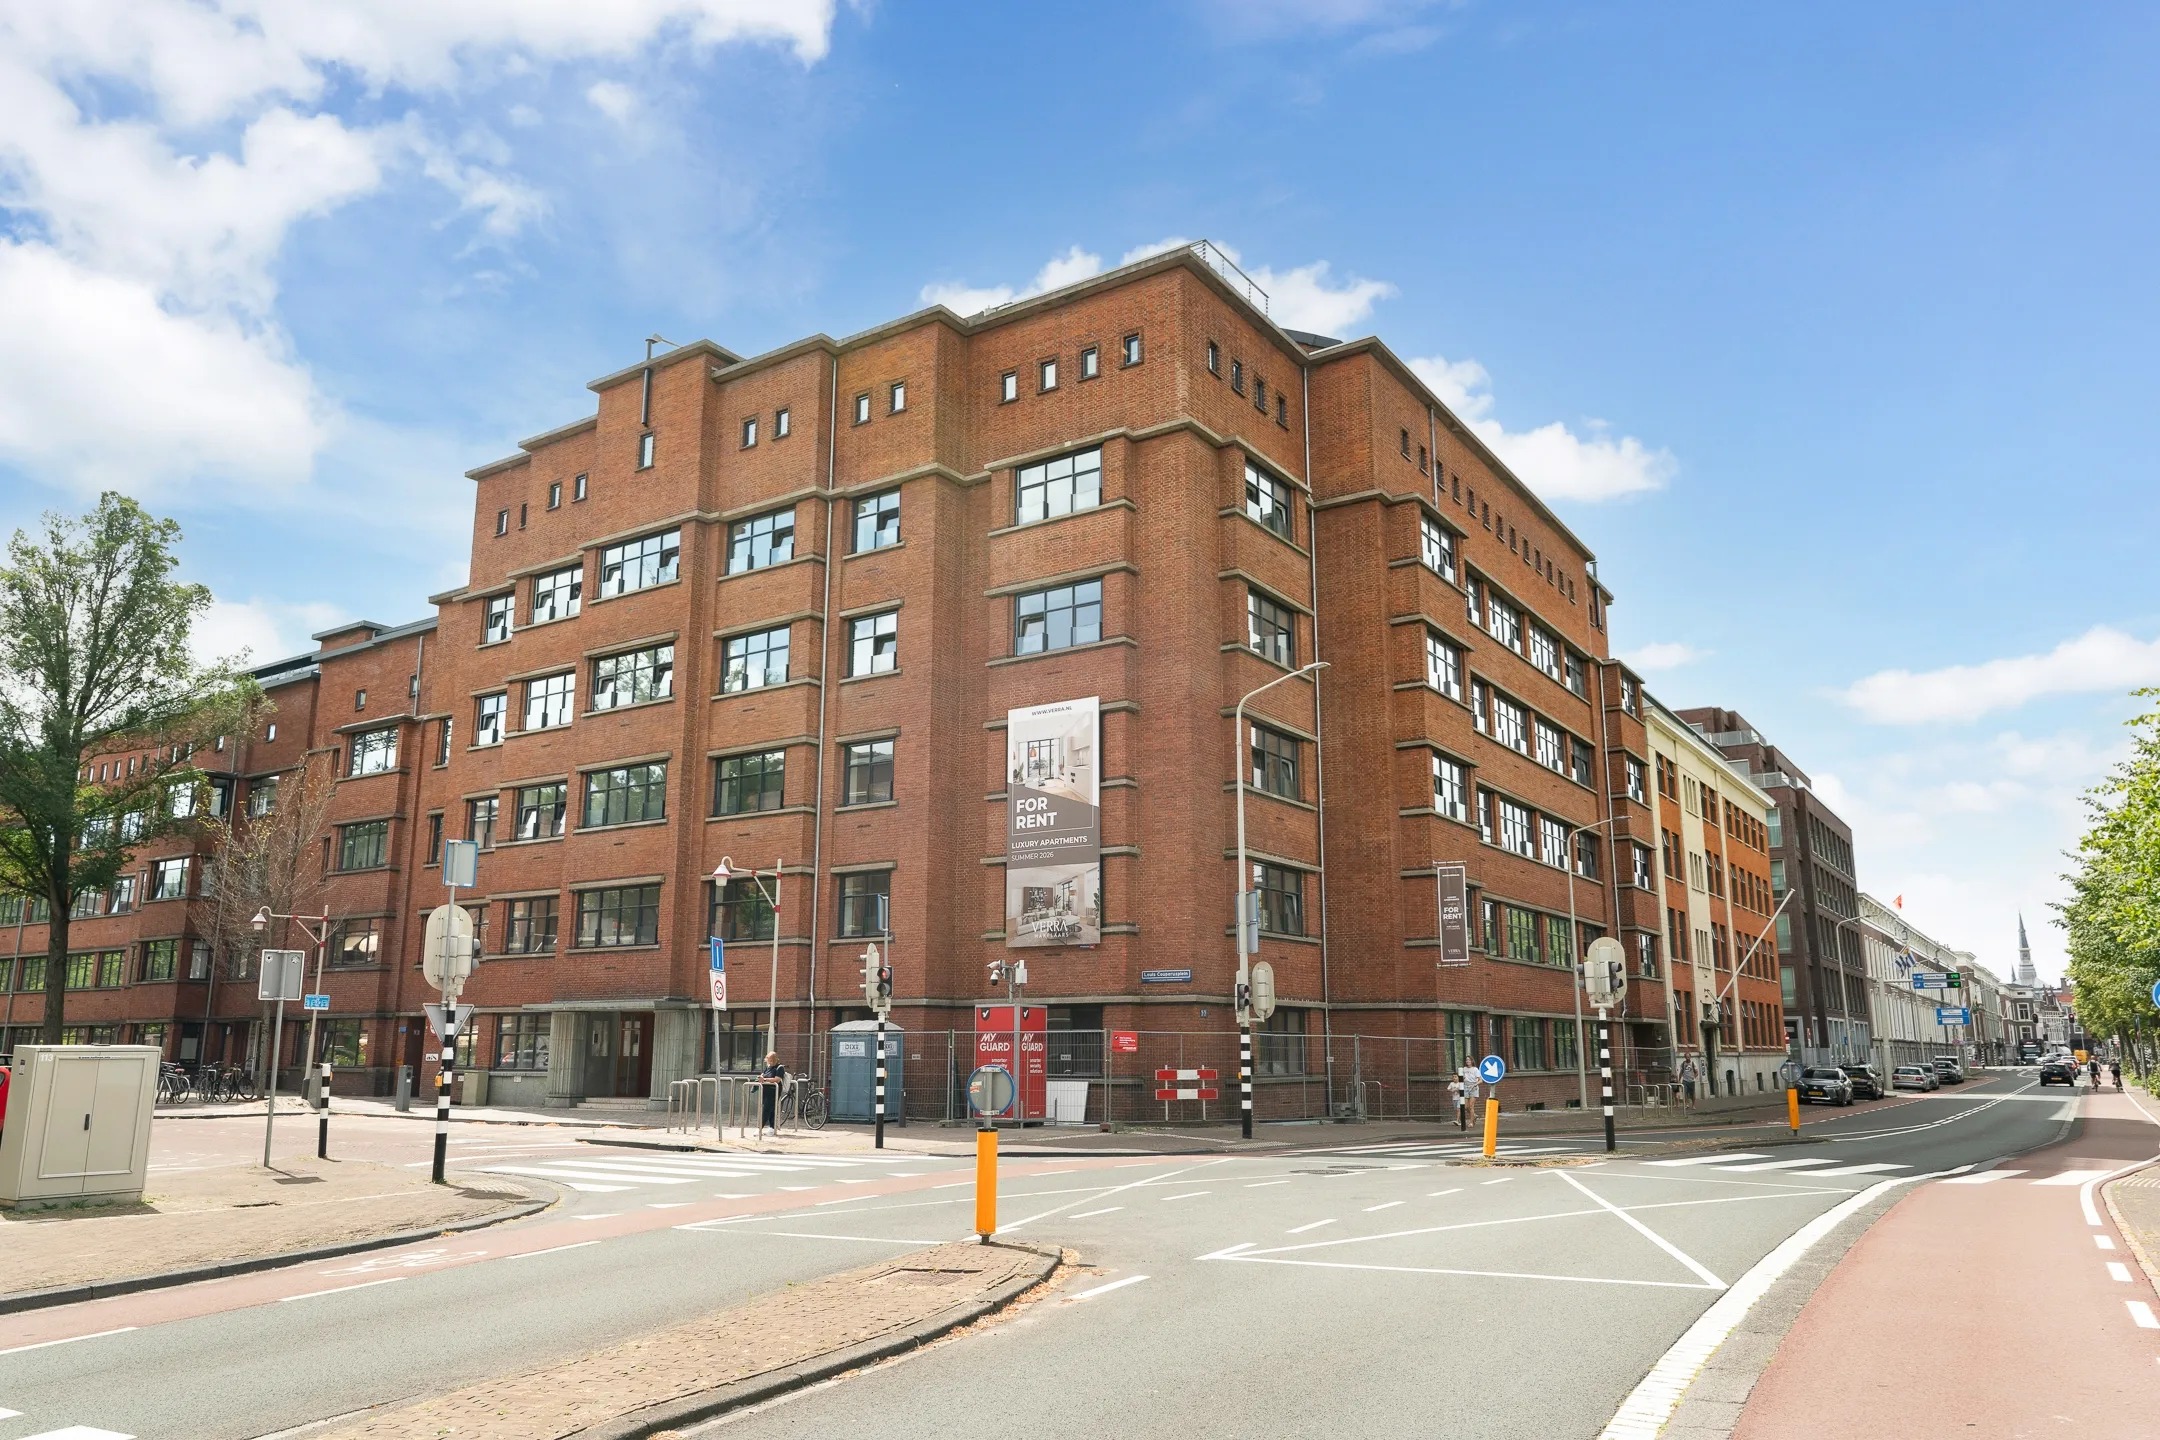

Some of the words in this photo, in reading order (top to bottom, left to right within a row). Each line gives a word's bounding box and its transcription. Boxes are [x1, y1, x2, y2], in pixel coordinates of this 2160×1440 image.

[1031, 705, 1072, 716] WWW.VERRA.NL
[1016, 796, 1048, 813] FOR
[1016, 811, 1057, 830] RENT
[1011, 840, 1039, 849] LUXURY
[1040, 835, 1088, 847] APARTMENTS
[1011, 852, 1039, 862] SUMMER
[1040, 851, 1054, 859] 2026
[1443, 912, 1463, 920] RENT
[1031, 920, 1068, 932] VERRA
[715, 985, 722, 995] 30
[980, 1033, 997, 1042] MY
[1022, 1033, 1034, 1041] MY
[980, 1042, 1010, 1052] GUARD
[1021, 1042, 1044, 1052] GUARD
[40, 1053, 54, 1062] 113
